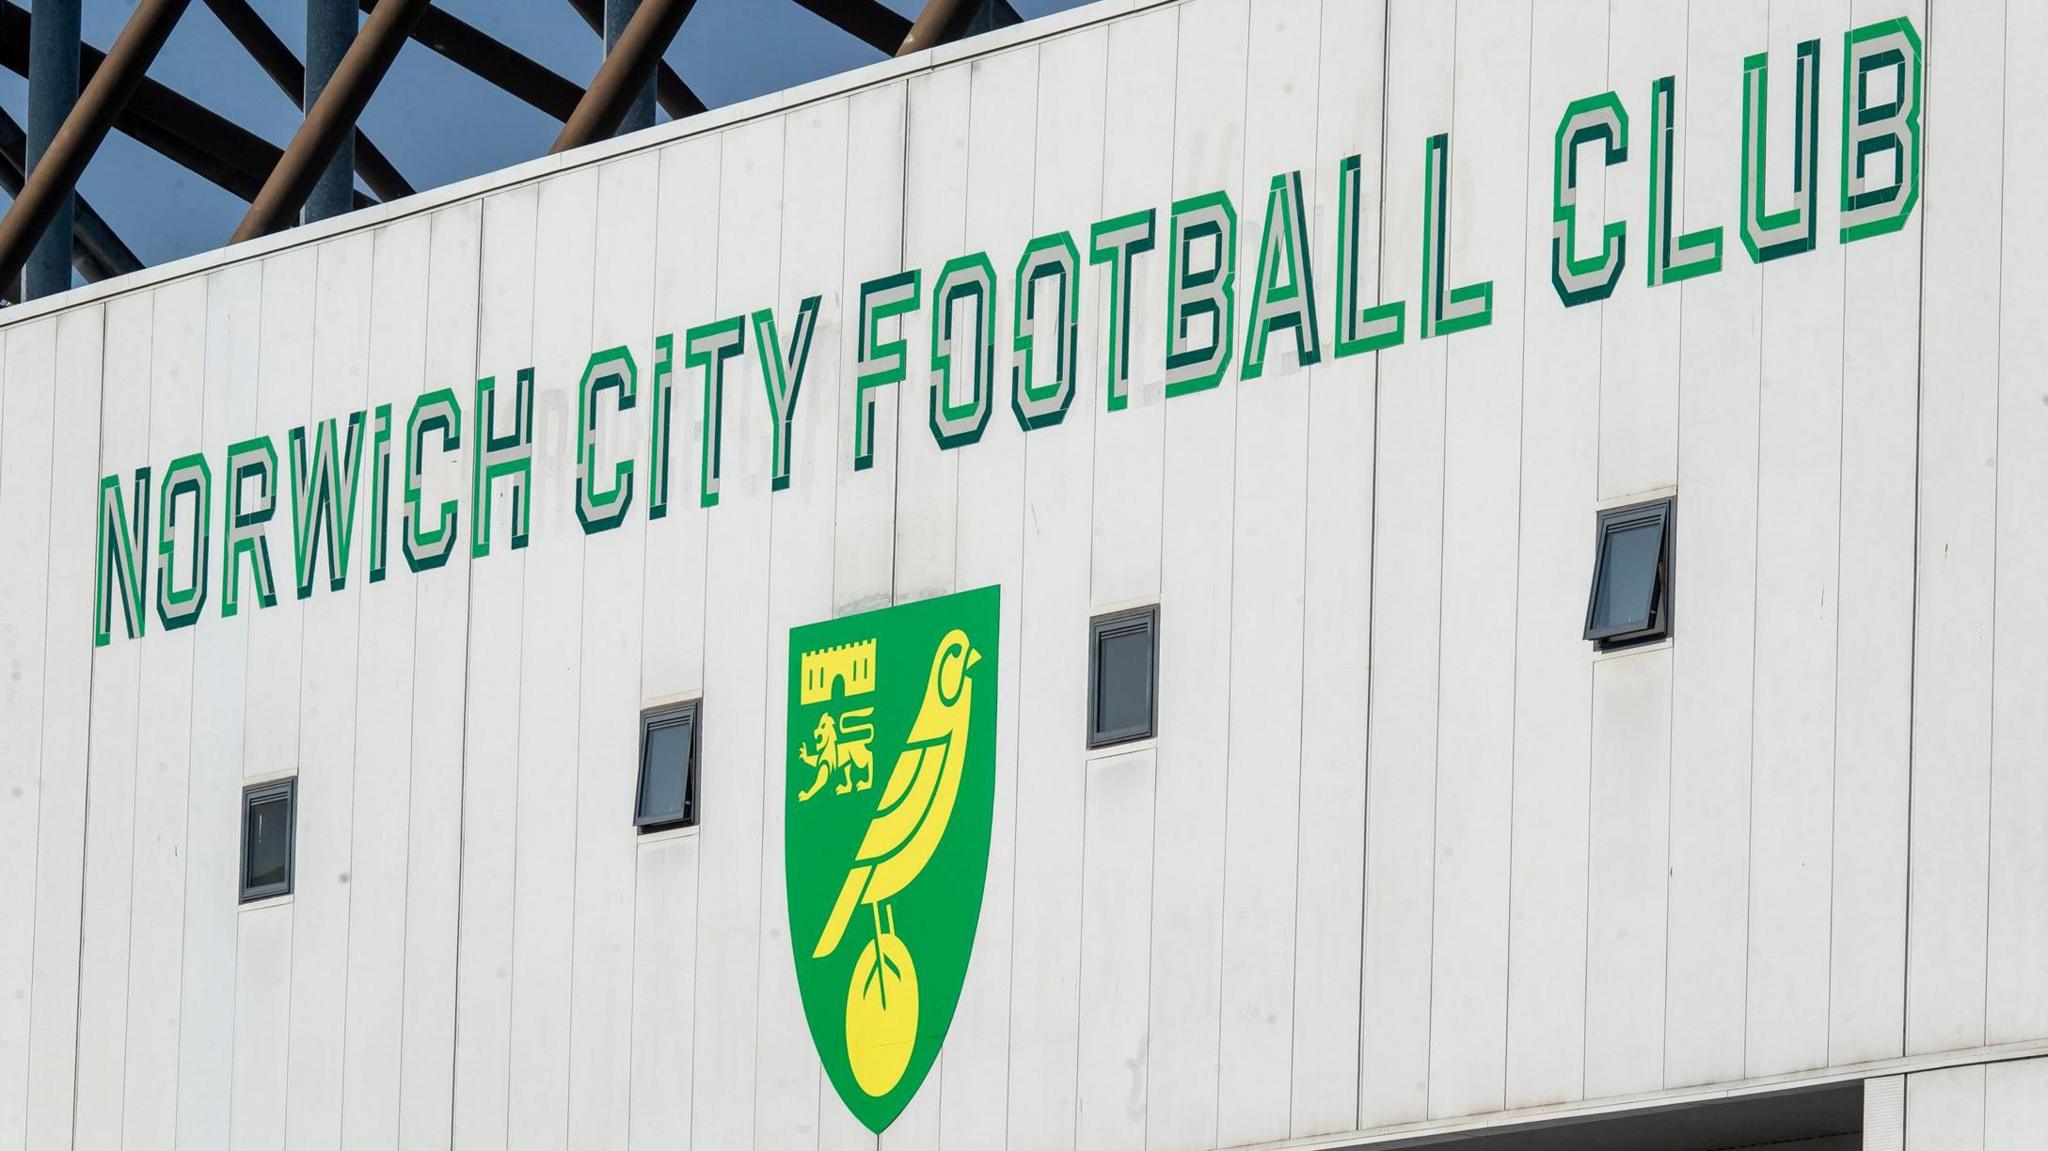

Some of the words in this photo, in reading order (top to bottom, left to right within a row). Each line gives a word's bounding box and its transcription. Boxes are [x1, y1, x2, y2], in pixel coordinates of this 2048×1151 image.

[95, 366, 535, 647] NORWICH
[575, 295, 823, 535] CITY
[854, 133, 1494, 471] FOOTBALL
[1551, 16, 1923, 308] CLUB
